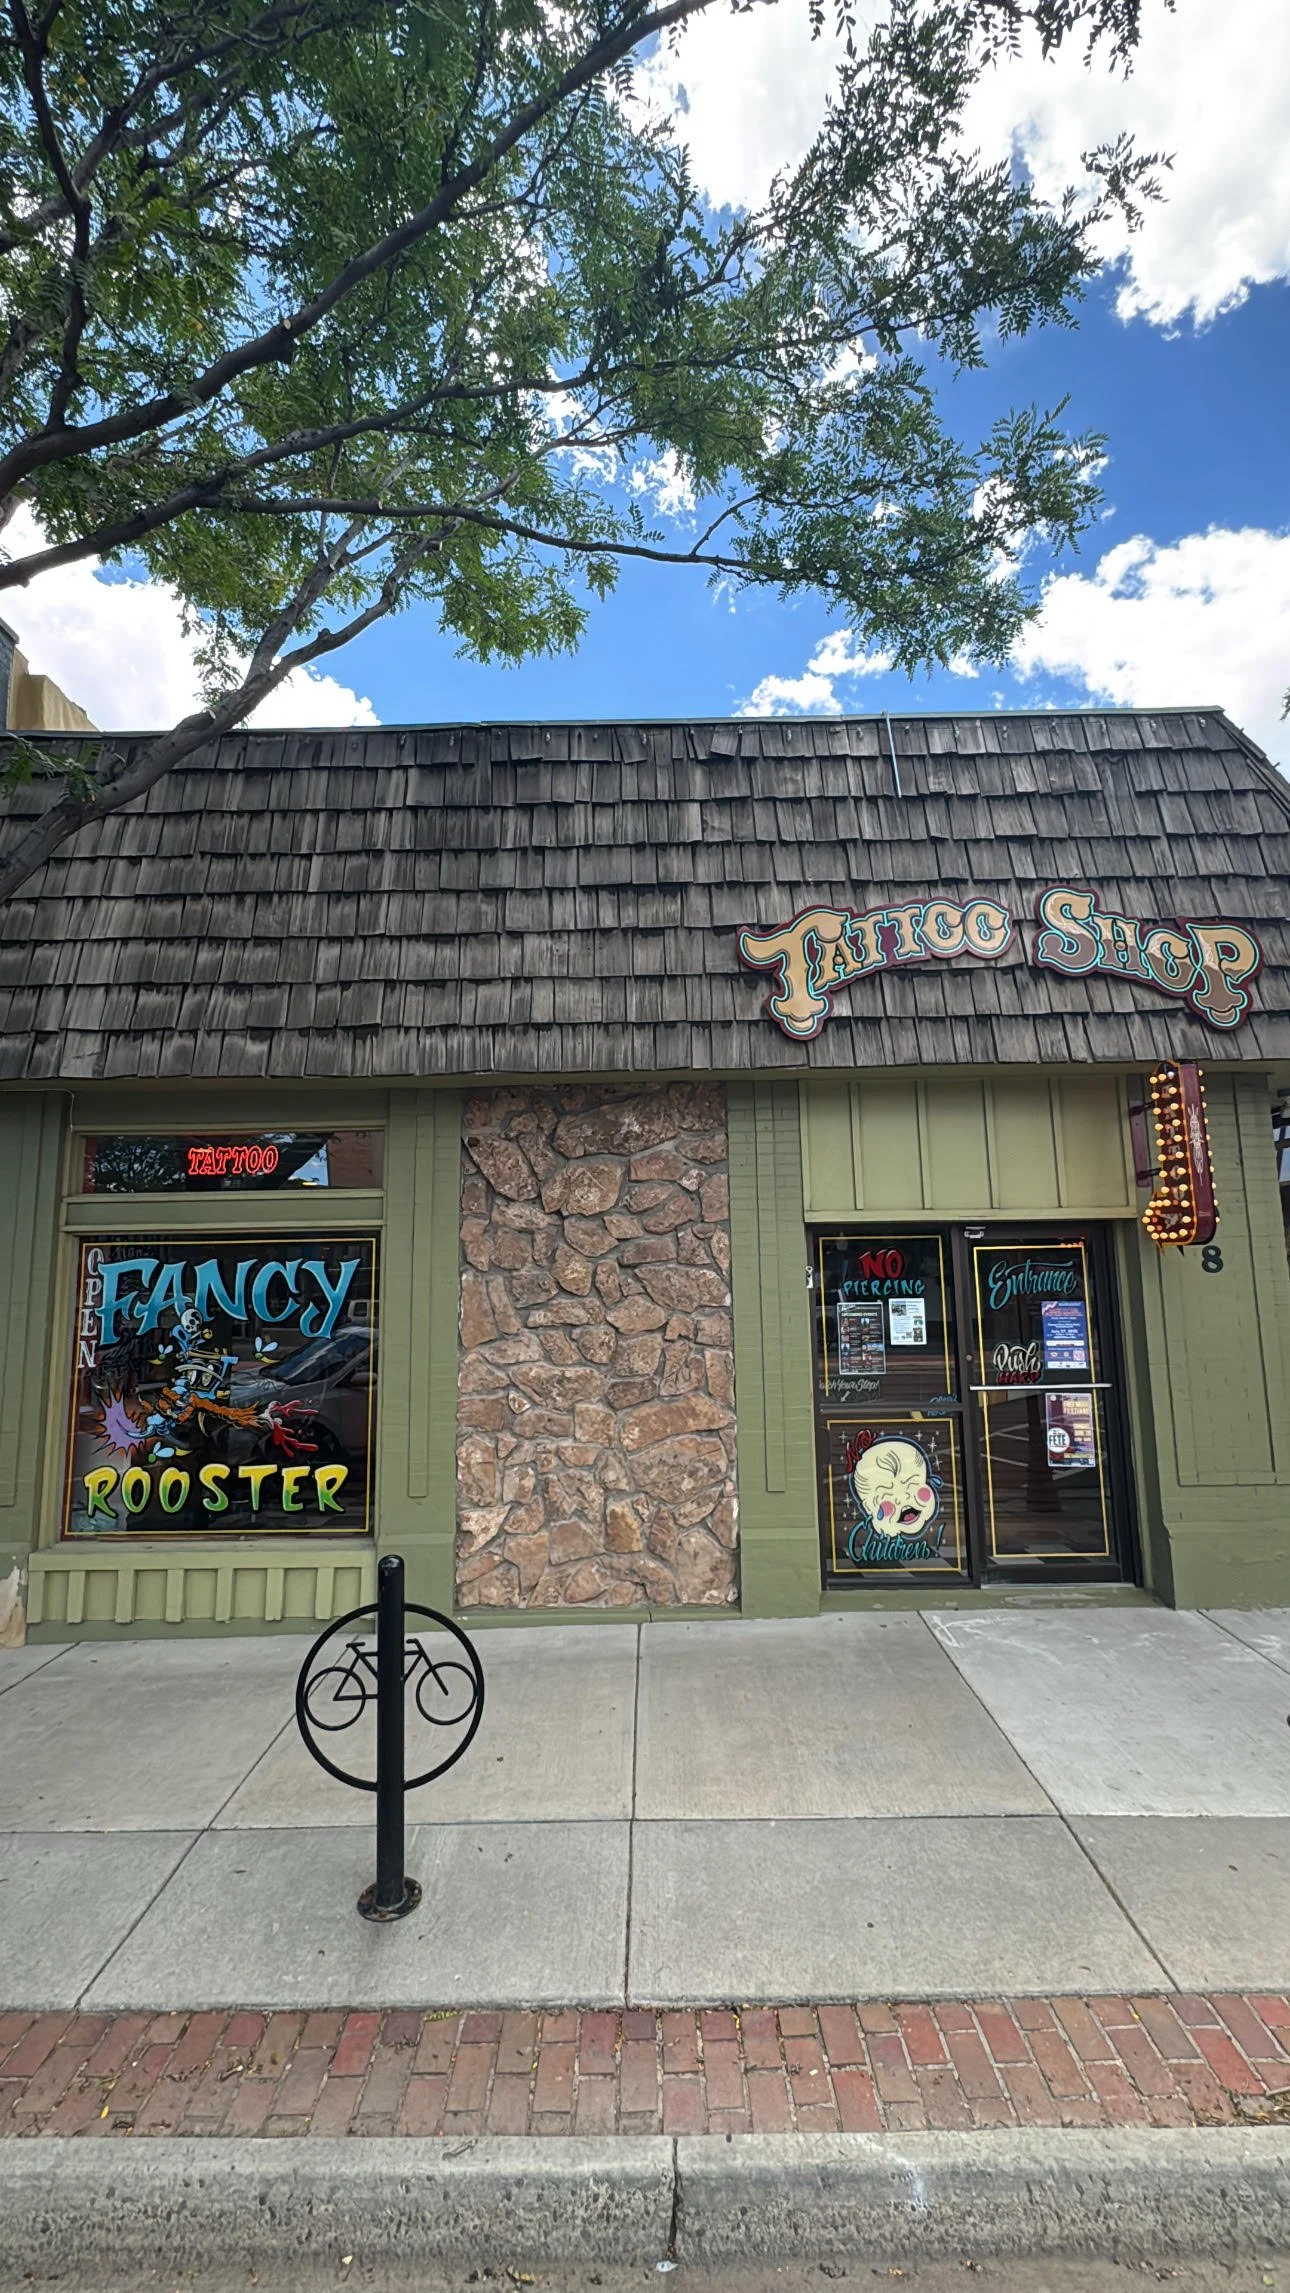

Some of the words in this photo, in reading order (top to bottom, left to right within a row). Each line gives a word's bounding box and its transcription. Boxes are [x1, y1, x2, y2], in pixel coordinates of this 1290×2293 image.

[187, 1145, 279, 1175] TATTOO
[858, 1249, 903, 1279] NO
[1202, 1245, 1223, 1273] 8
[843, 1280, 925, 1296] PIERCING
[988, 1258, 1077, 1310] Entrance
[77, 1248, 105, 1368] OPEN
[95, 1257, 361, 1345] FANCY
[993, 1342, 1041, 1372] Push
[856, 1378, 880, 1391] Step!
[83, 1463, 349, 1518] ROOSTER
